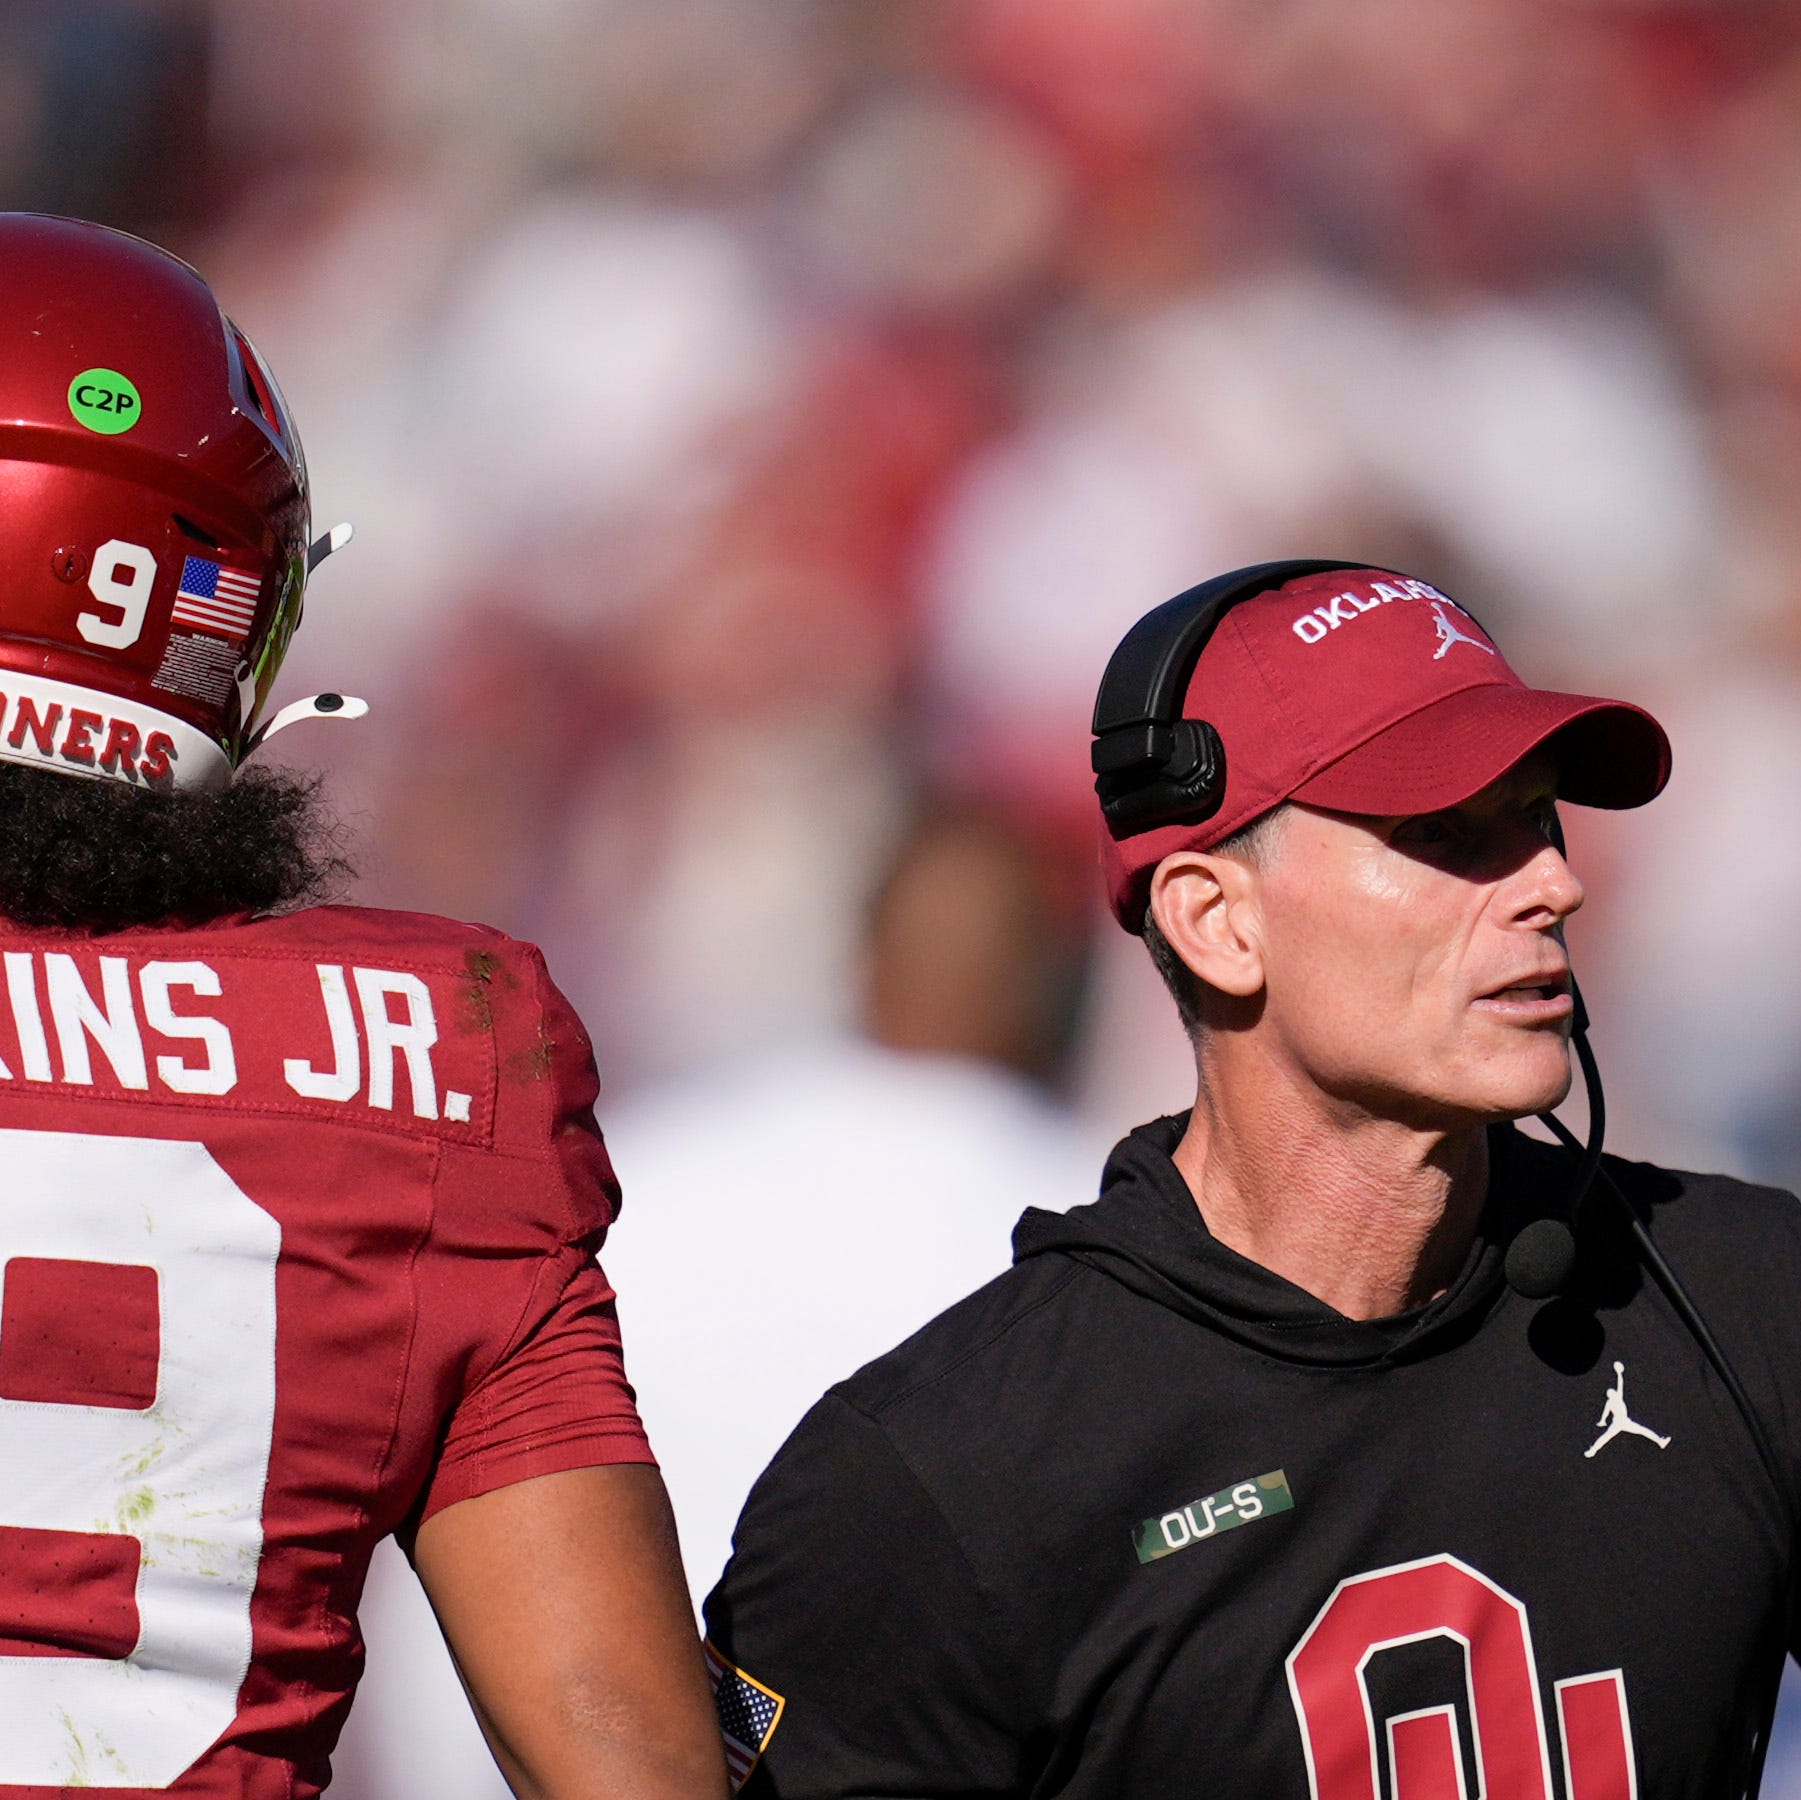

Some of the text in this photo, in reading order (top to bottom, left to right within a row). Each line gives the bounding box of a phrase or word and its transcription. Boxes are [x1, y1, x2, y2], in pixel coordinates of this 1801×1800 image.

[75, 385, 134, 414] C2P
[76, 539, 158, 650] 9
[283, 963, 472, 1123] JR.
[1160, 1483, 1263, 1549] OU-S
